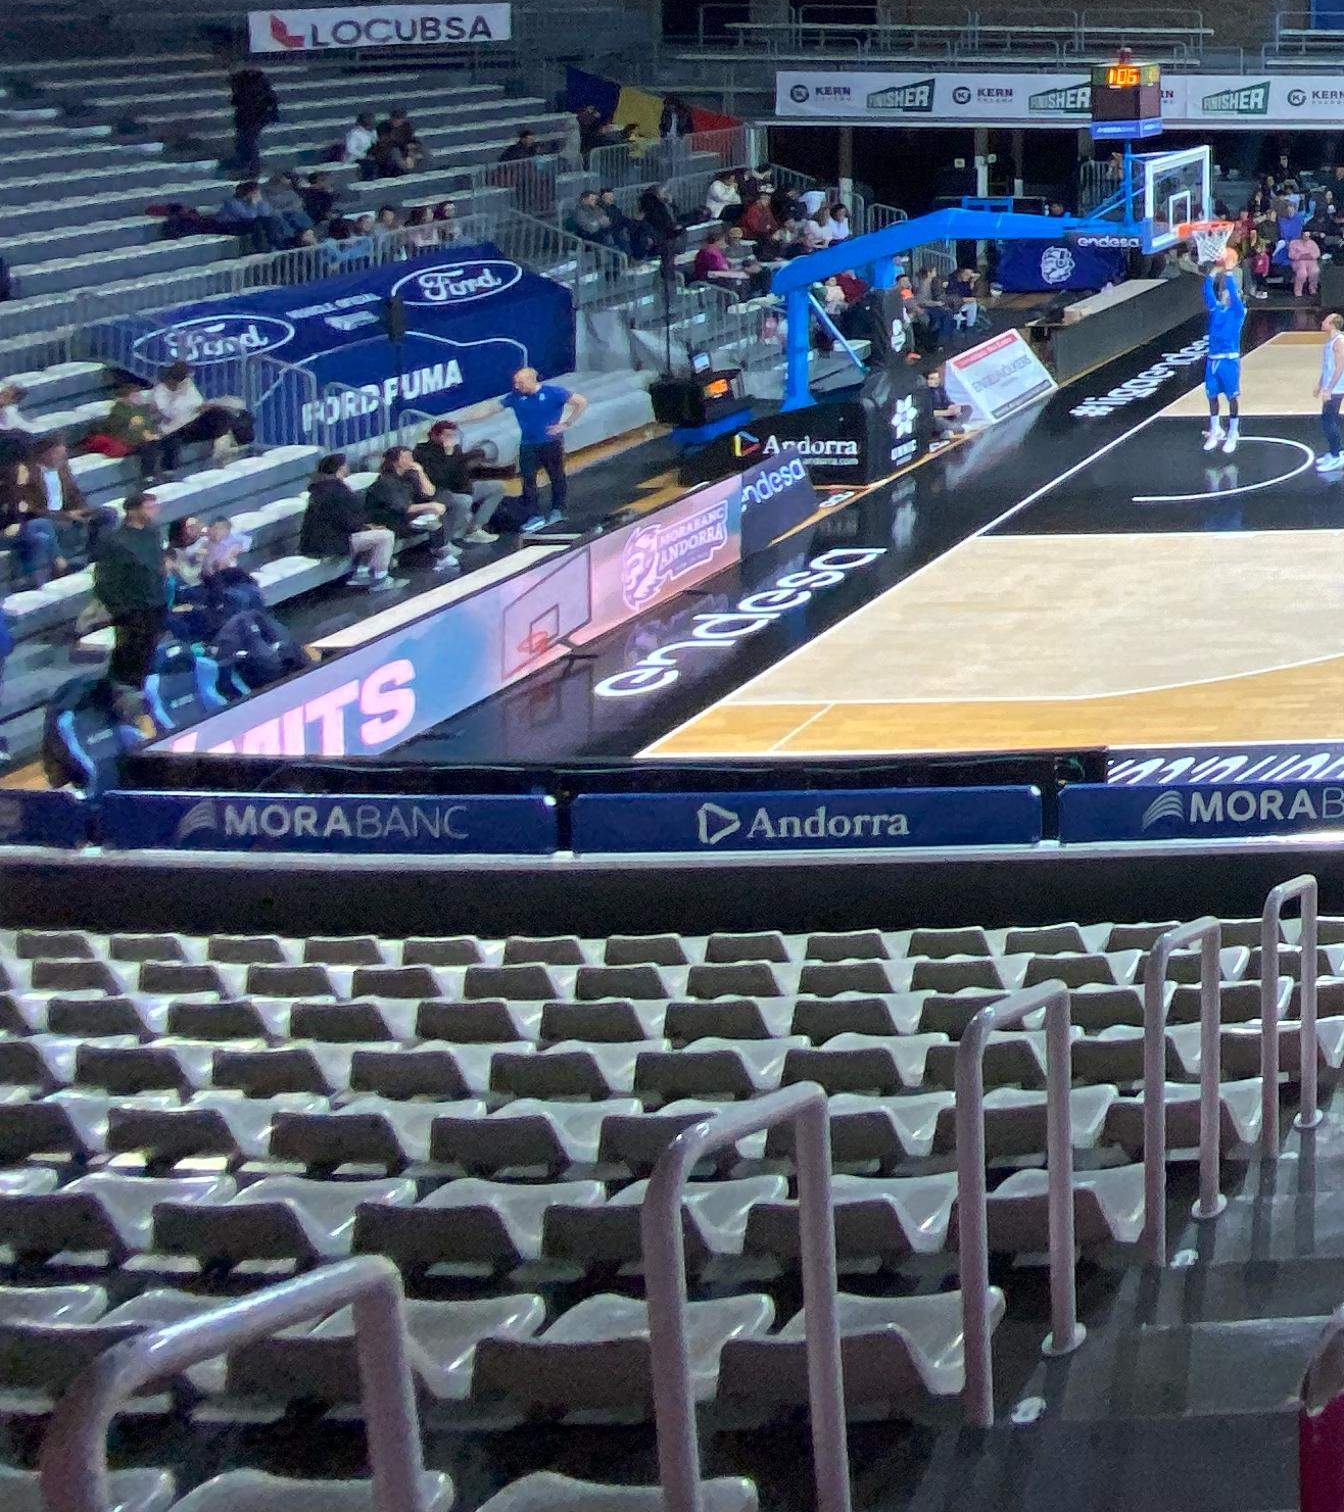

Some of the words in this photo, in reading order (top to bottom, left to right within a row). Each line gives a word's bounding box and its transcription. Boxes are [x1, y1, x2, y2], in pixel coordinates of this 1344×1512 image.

[311, 14, 493, 48] LOCUBSA
[977, 87, 1013, 98] KERN
[1077, 235, 1141, 248] endesa
[419, 268, 503, 303] Ford
[660, 522, 725, 565] ANDORRA
[593, 547, 887, 698] endesa
[745, 805, 910, 842] Andorra
